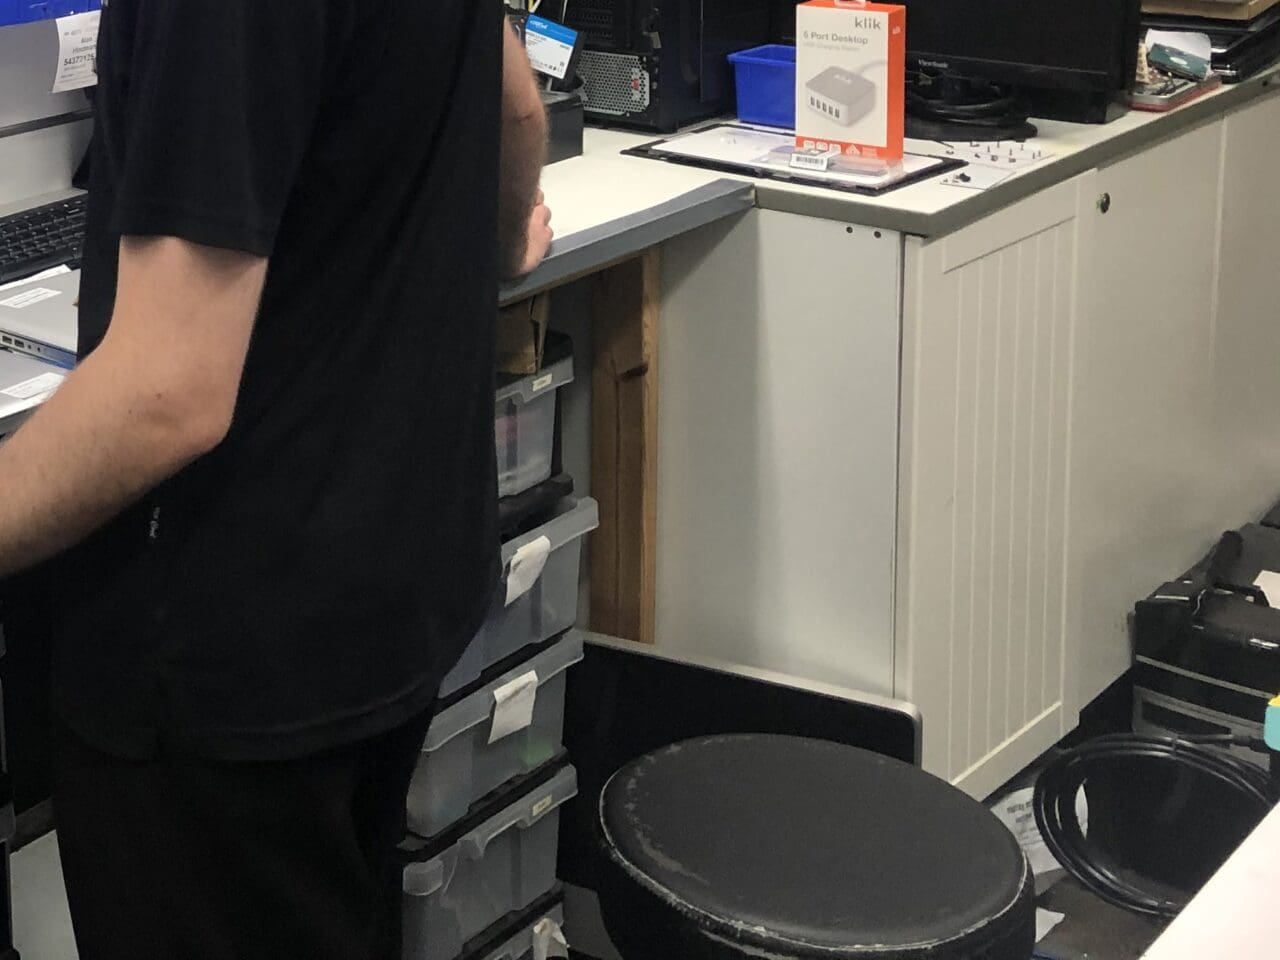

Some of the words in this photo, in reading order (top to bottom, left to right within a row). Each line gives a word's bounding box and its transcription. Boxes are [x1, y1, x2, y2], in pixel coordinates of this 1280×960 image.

[854, 16, 881, 30] klik
[811, 31, 829, 41] Port
[831, 32, 869, 46] Desktop
